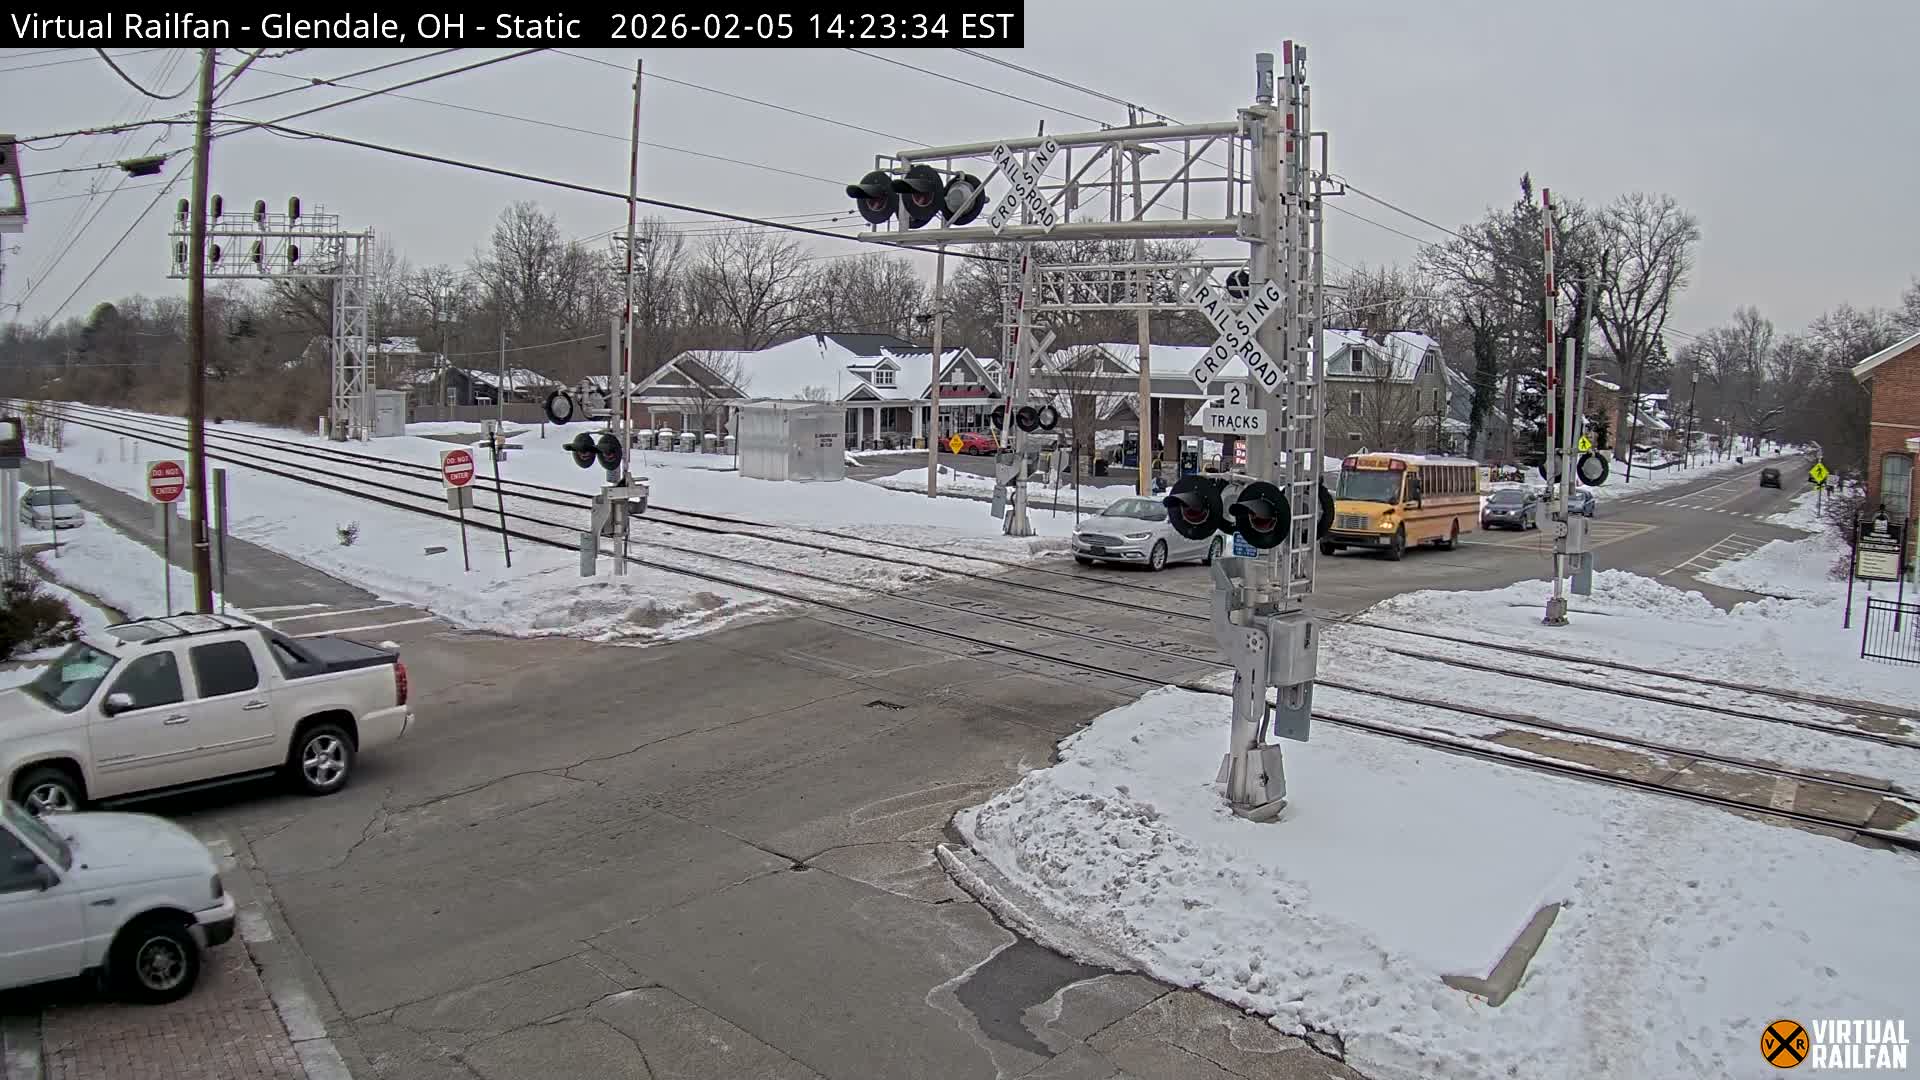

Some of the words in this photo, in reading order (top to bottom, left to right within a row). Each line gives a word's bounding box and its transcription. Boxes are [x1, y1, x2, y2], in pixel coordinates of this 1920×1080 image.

[991, 140, 1056, 229] CROSSING
[993, 144, 1055, 228] RAILROAD
[1194, 286, 1280, 384] CROSSING
[1194, 286, 1278, 387] RAILROAD
[1230, 388, 1240, 405] 2
[1211, 414, 1259, 430] TRACKS
[446, 457, 455, 465] DO
[457, 455, 469, 463] NOT
[152, 469, 162, 477] DO
[450, 471, 469, 480] ENTER
